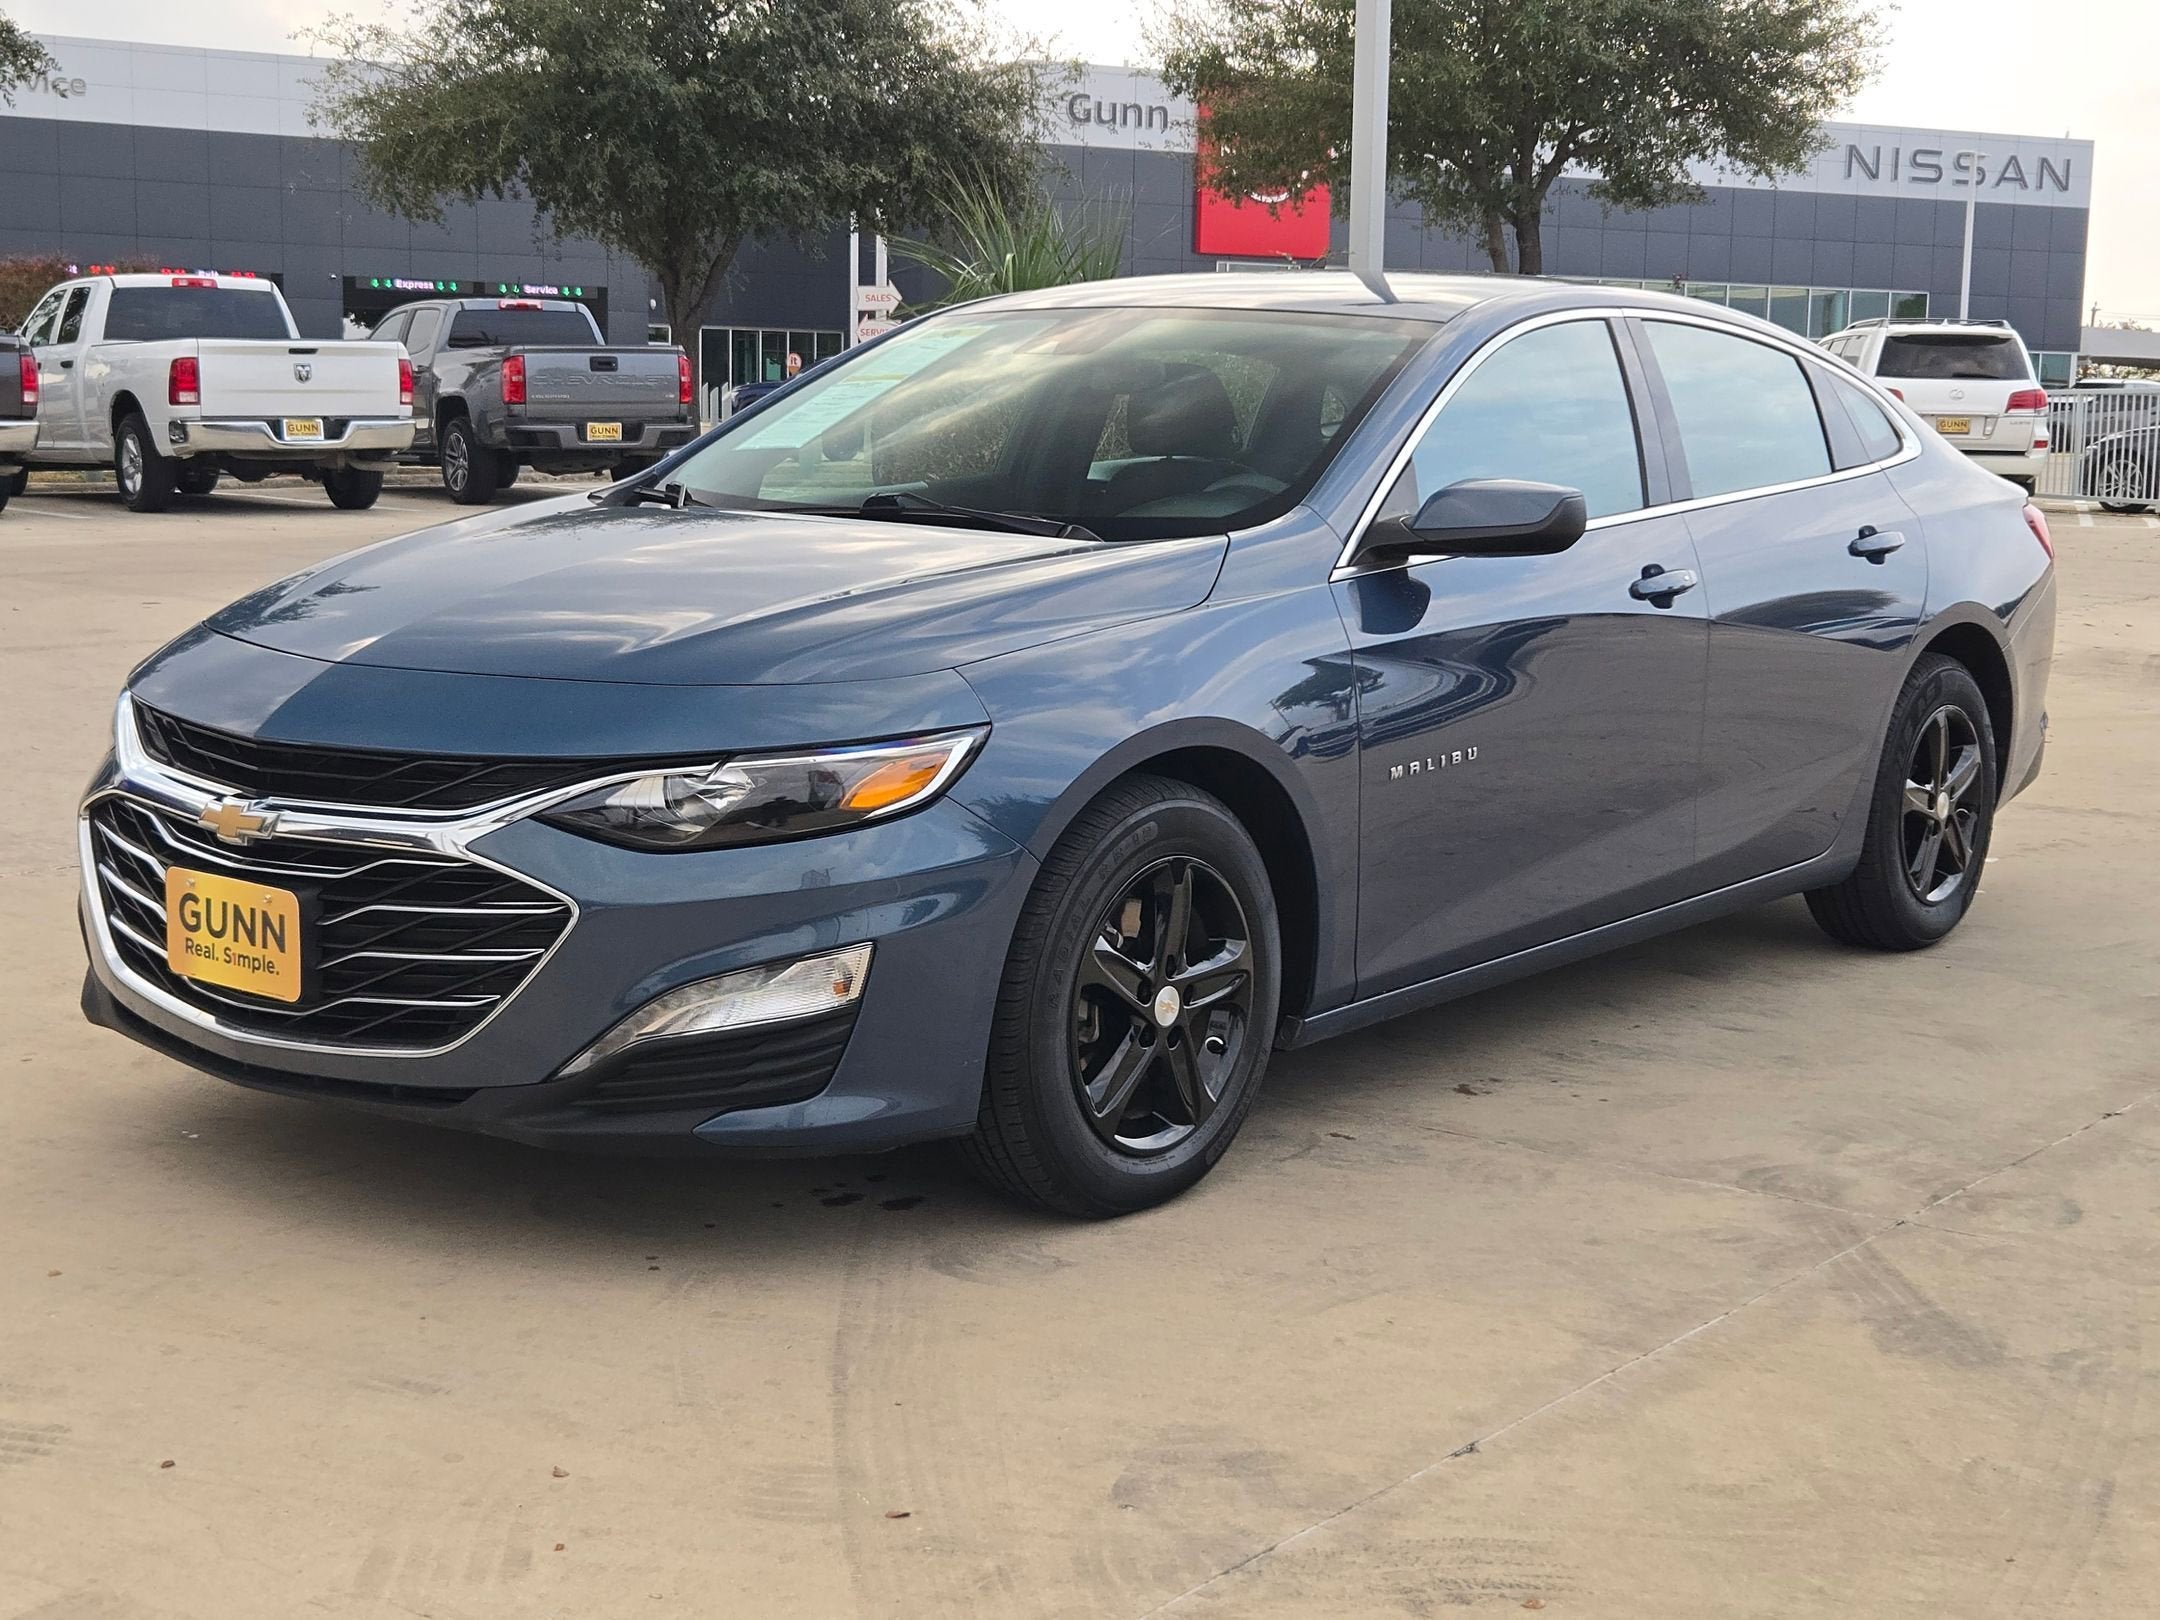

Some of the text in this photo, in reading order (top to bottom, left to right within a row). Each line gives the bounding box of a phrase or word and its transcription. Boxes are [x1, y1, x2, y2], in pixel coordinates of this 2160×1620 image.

[1068, 94, 1168, 130] Gunn
[1845, 143, 2072, 192] NISSAN
[394, 279, 434, 290] Express
[523, 285, 559, 295] Service
[865, 294, 891, 302] SALES
[860, 328, 889, 337] SERVI
[288, 423, 319, 432] GUNN
[1940, 420, 1967, 428] GUNN
[590, 426, 618, 435] GUNN
[1390, 746, 1478, 780] MALIBU
[179, 892, 286, 954] GUNN
[185, 937, 219, 962] Real.
